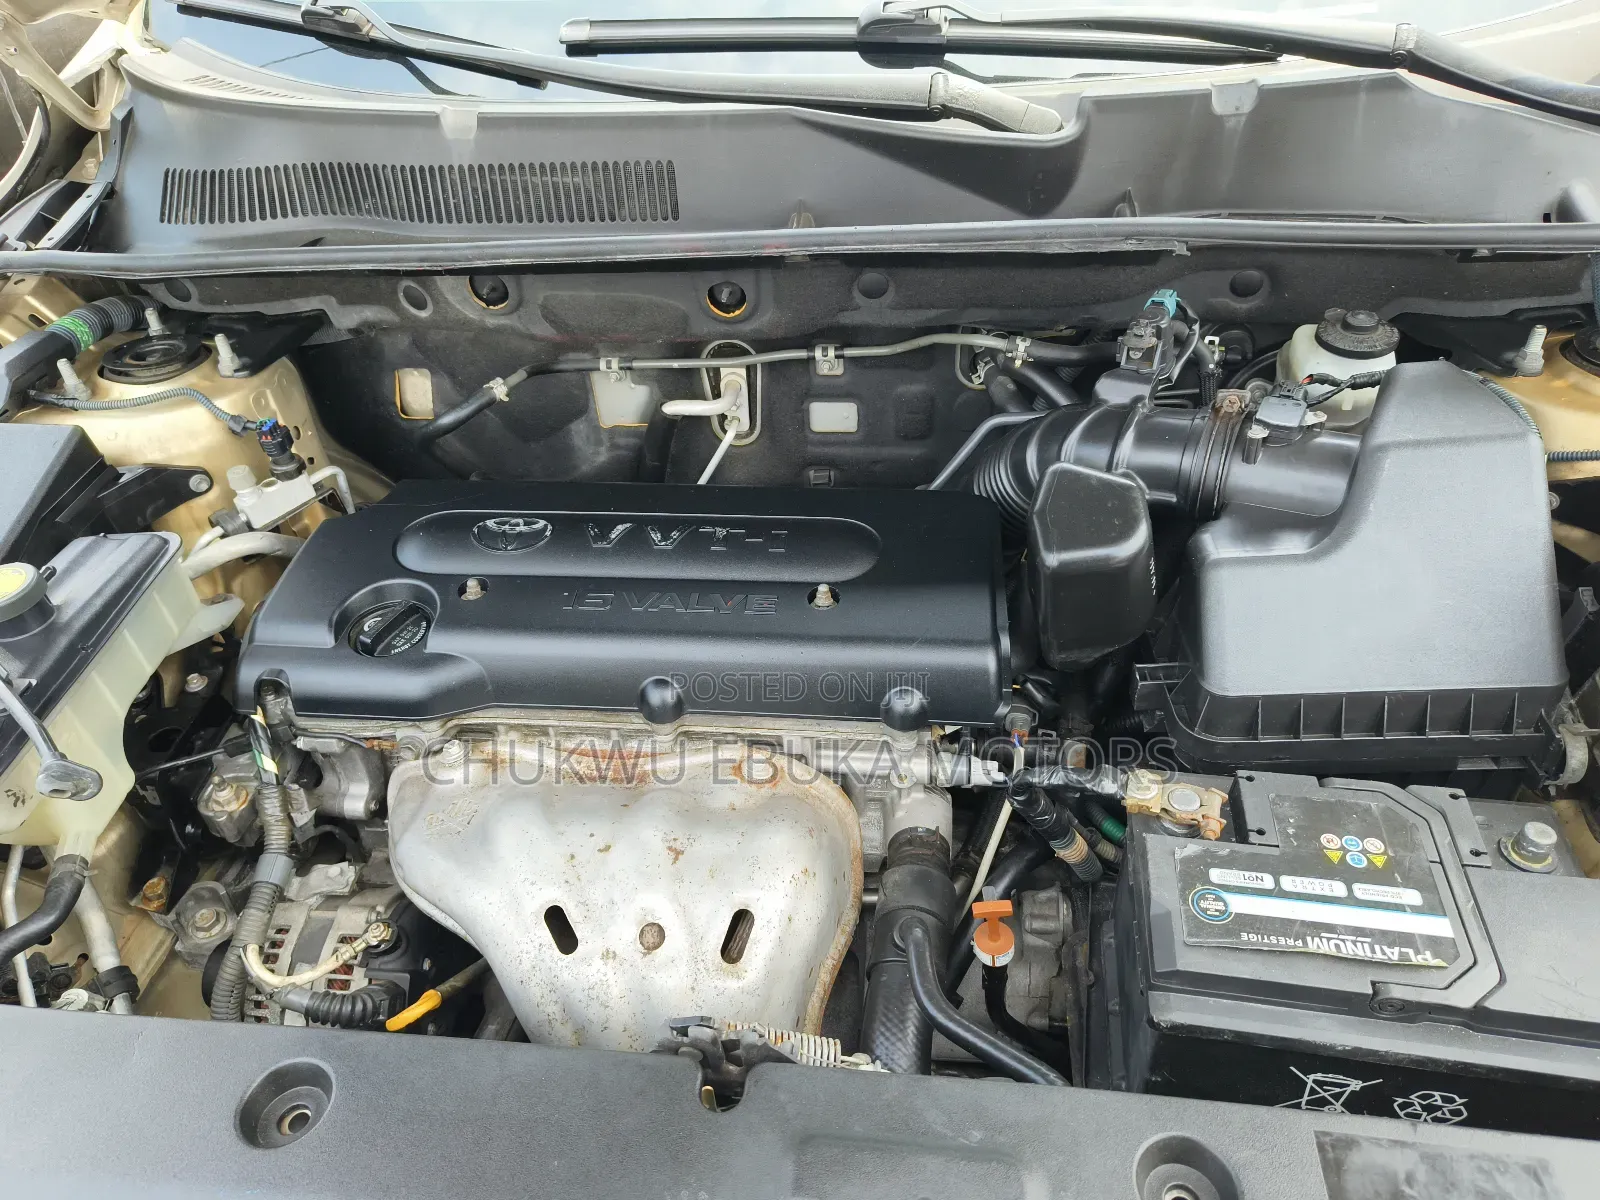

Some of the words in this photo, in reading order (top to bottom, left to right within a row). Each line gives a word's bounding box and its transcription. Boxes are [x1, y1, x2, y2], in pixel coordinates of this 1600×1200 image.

[622, 591, 778, 615] VALVE
[1291, 879, 1333, 888] POWER
[1292, 884, 1334, 893] EXTRA
[1240, 932, 1303, 947] PRESTIGE
[1307, 936, 1434, 963] PLATINUM
